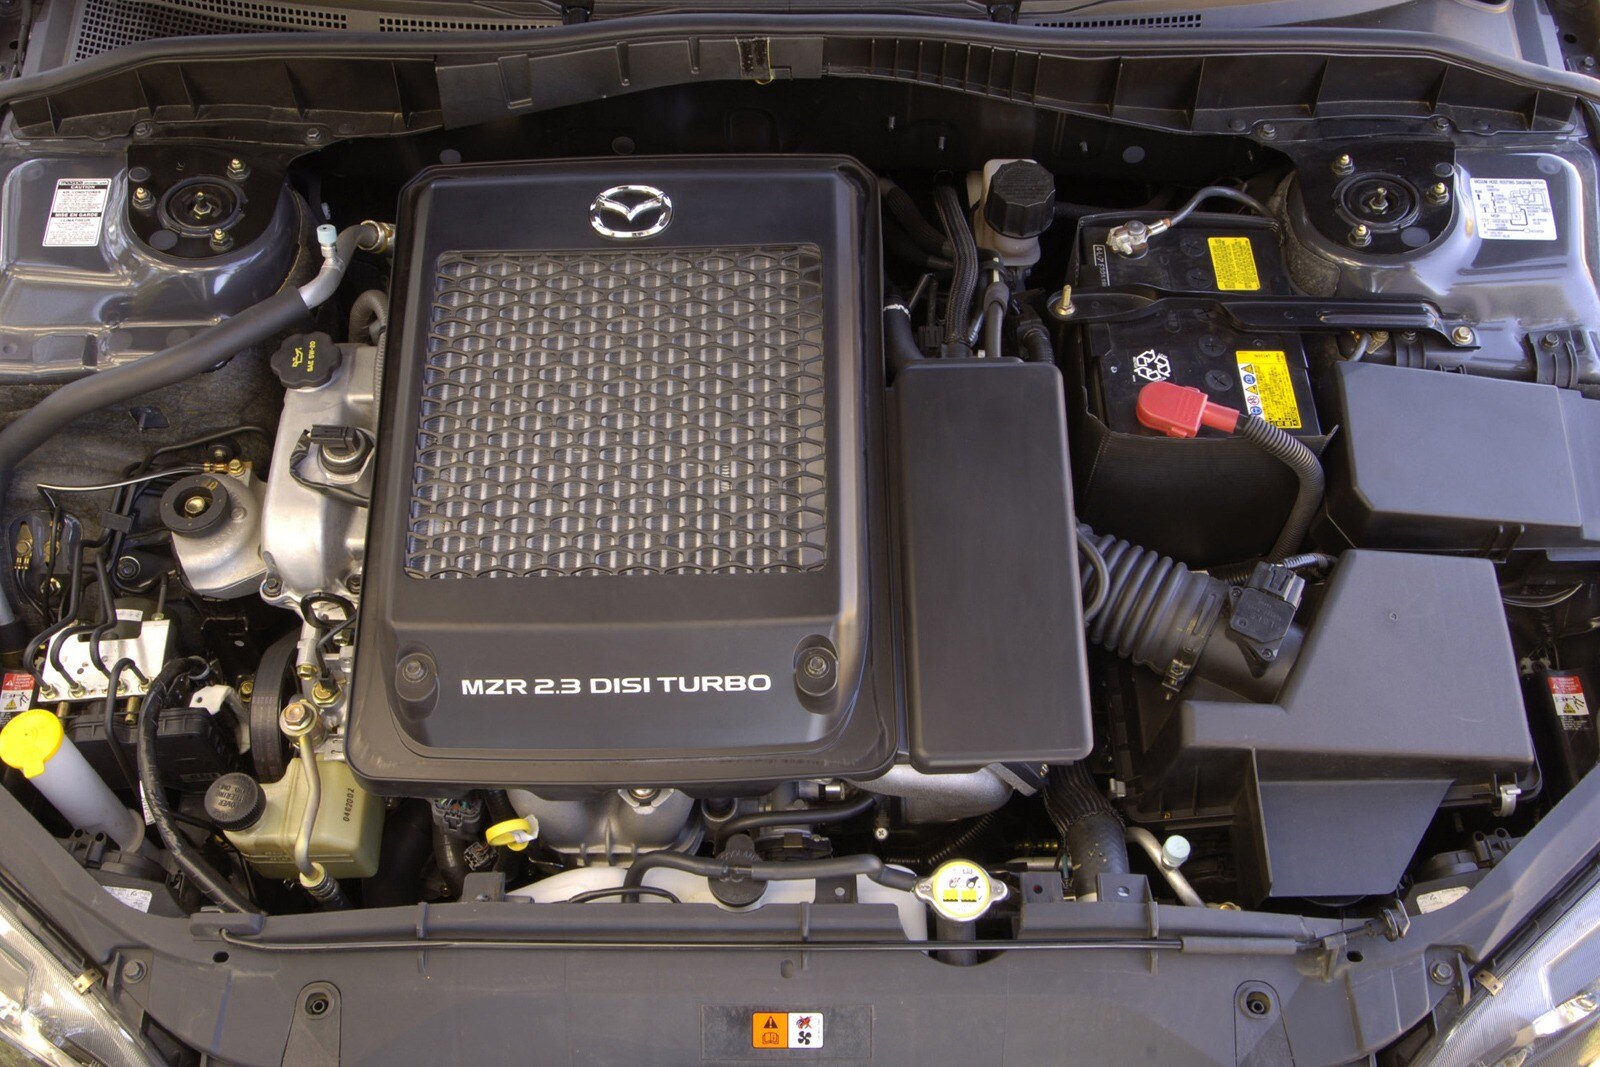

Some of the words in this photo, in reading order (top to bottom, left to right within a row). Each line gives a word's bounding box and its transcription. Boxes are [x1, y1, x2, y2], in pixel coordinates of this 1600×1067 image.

[461, 679, 528, 695] MZR
[534, 678, 581, 694] 2.3
[590, 677, 650, 694] DISI
[657, 674, 771, 693] TURBO
